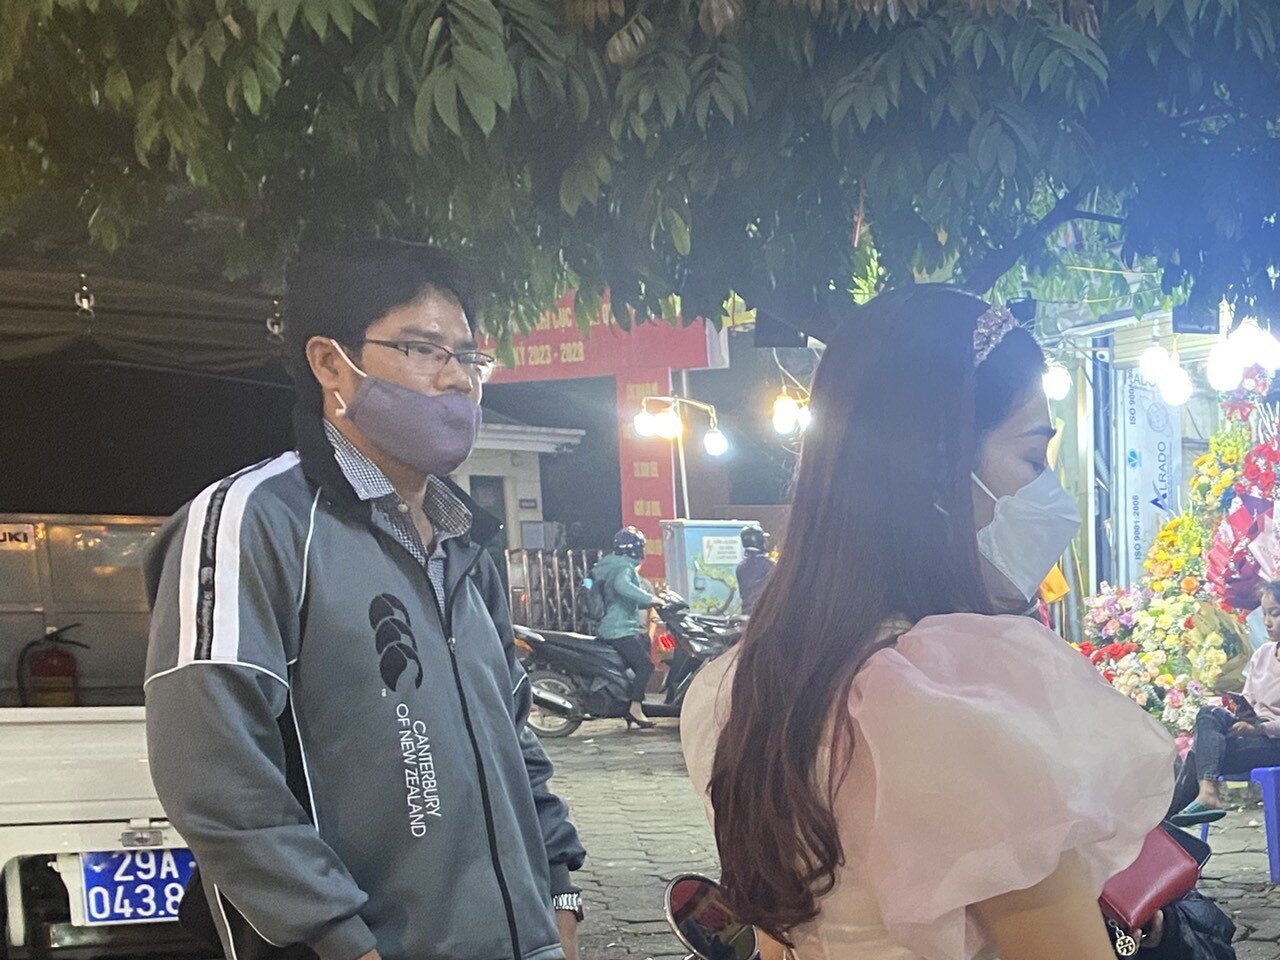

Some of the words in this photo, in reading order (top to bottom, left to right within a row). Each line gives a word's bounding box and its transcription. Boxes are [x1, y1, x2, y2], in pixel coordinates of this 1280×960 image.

[396, 703, 411, 727] OF
[399, 730, 417, 765] NEW
[413, 720, 442, 817] CANTERBURY
[405, 768, 426, 837] ZEALAND
[112, 850, 180, 881] 29A
